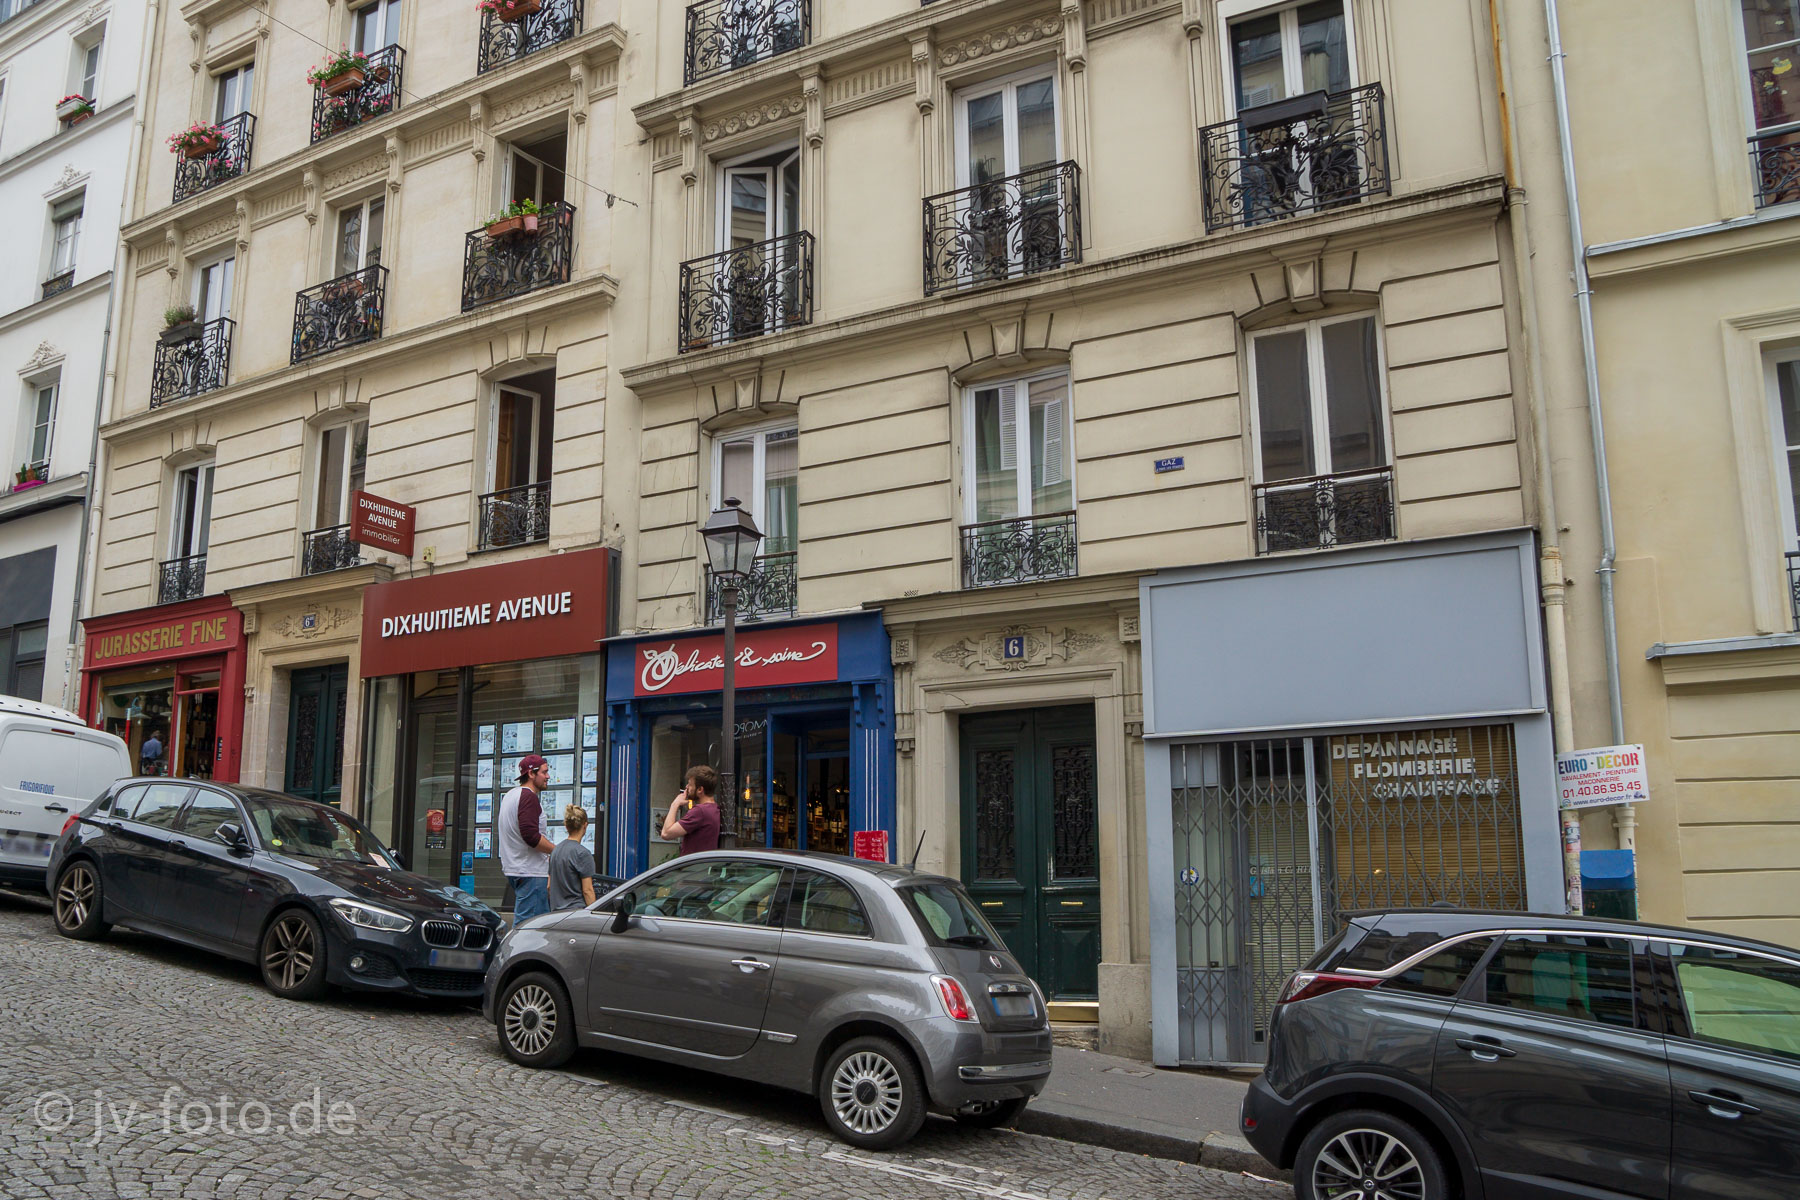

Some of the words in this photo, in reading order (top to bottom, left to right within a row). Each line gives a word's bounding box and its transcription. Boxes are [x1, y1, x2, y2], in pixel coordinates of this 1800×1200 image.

[1161, 458, 1176, 467] GAZ
[360, 498, 406, 520] DIXHUITIEME
[368, 513, 397, 529] AVENUE
[362, 526, 400, 545] immobilier
[381, 603, 491, 638] DIXHUITIEME
[496, 591, 572, 622] AVENUE
[95, 624, 185, 660] JURASSERIE
[190, 616, 228, 644] FINE
[1008, 638, 1019, 657] 6
[739, 647, 763, 667] &
[1332, 737, 1458, 759] DEPANNAGE
[1353, 757, 1477, 778] PLOMBERIE
[1558, 758, 1588, 775] EURO
[1596, 752, 1639, 770] DECOR
[1561, 771, 1601, 782] RAVALEMENT
[1605, 767, 1638, 776] PEINTURE
[20, 780, 55, 795] FRIGORIFIQUE
[1373, 778, 1500, 798] CHAUFFAGE
[1562, 781, 1642, 798] 01.40.86.95.45
[1573, 794, 1632, 806] www.euro-decor.fr
